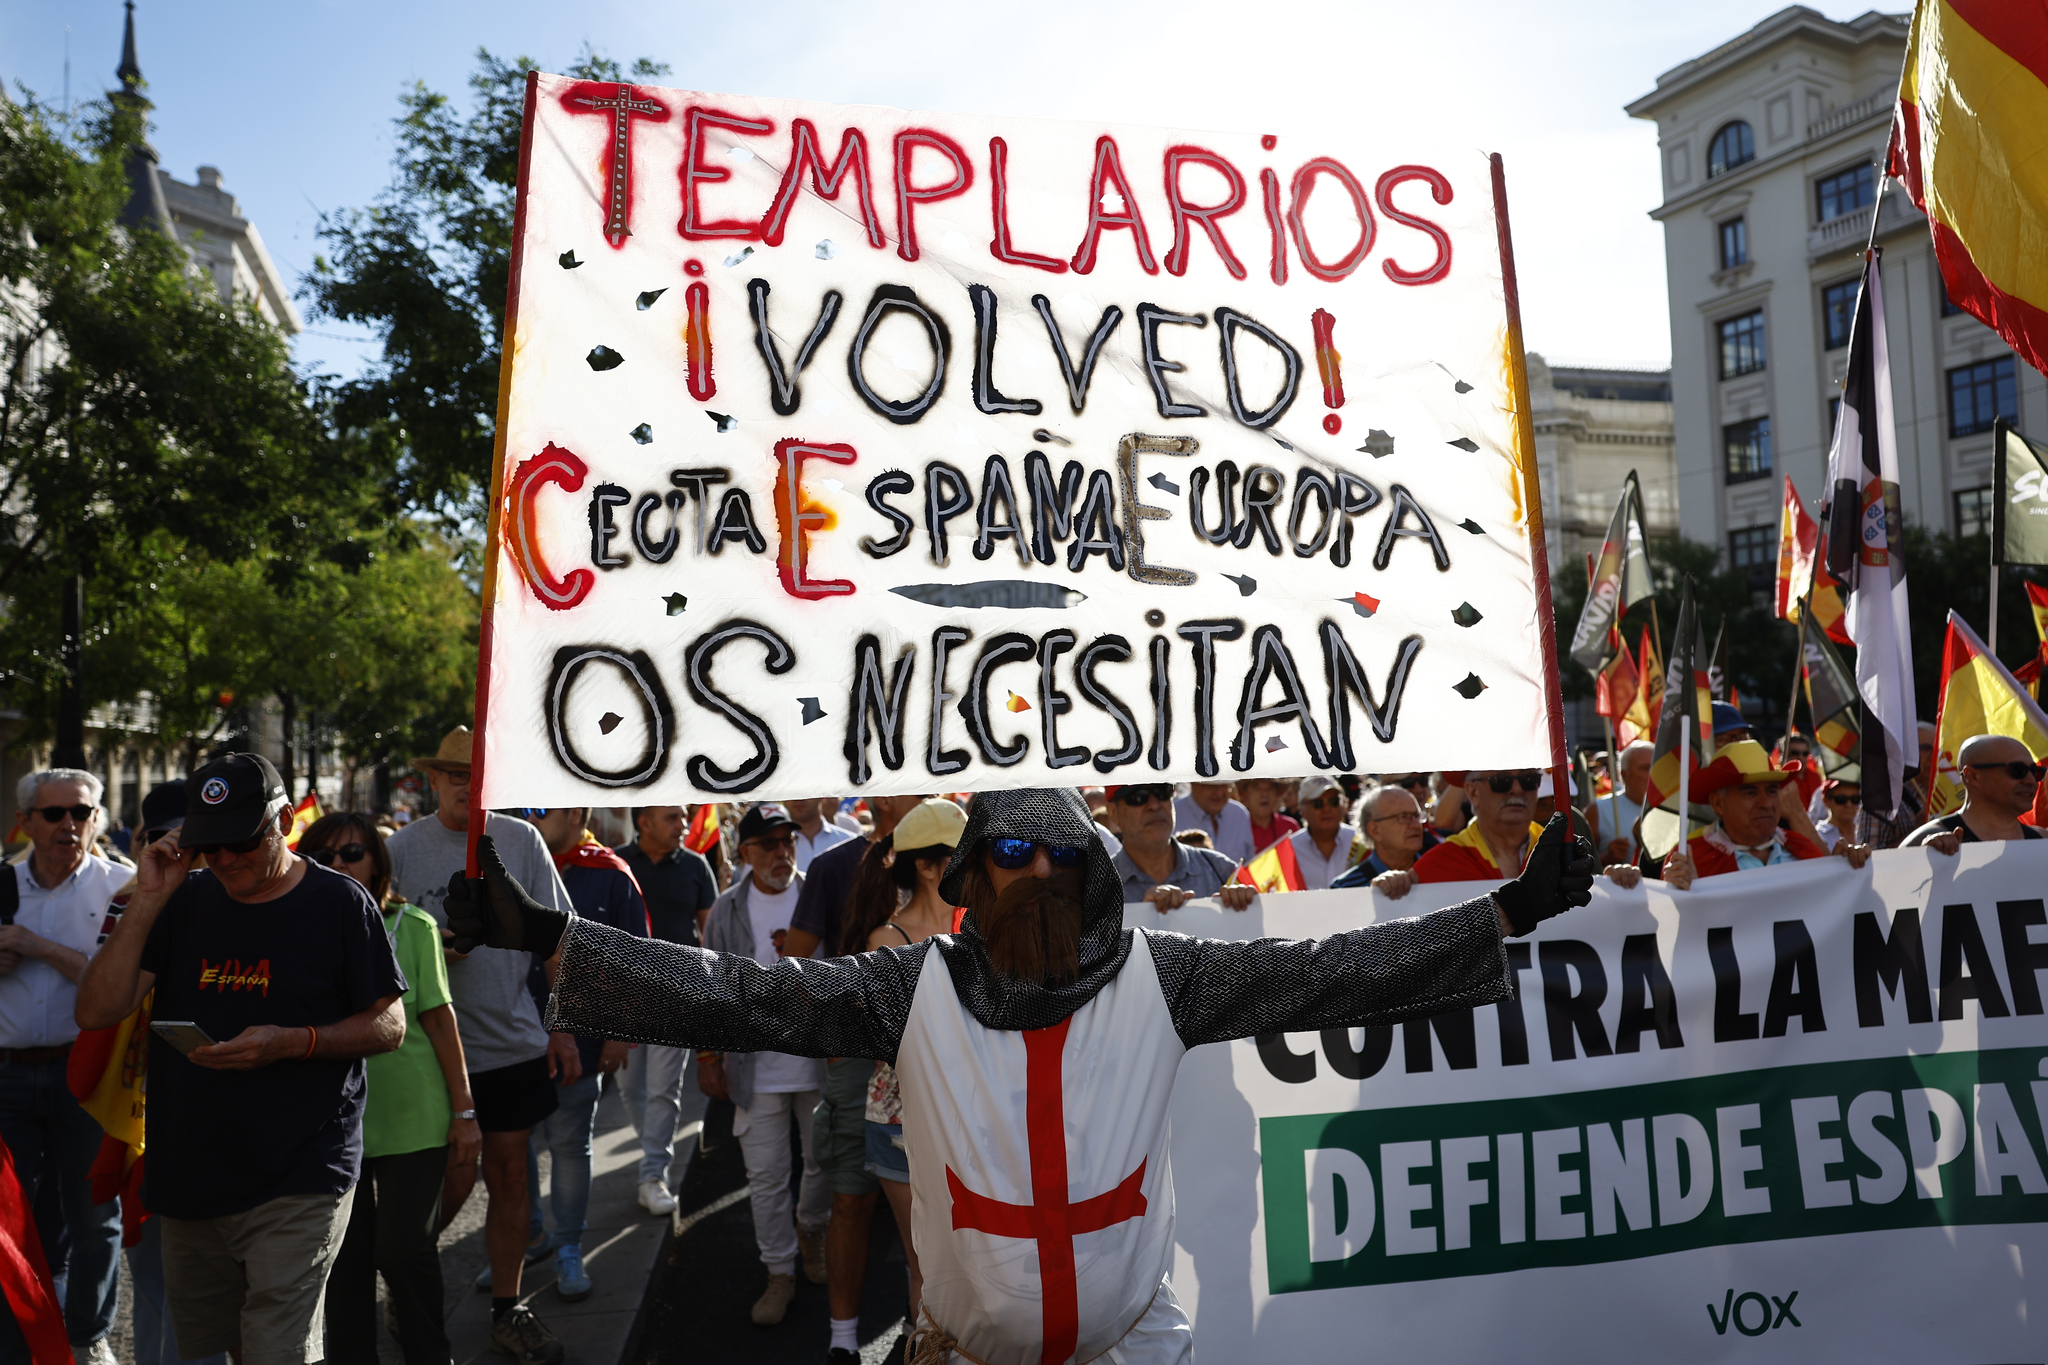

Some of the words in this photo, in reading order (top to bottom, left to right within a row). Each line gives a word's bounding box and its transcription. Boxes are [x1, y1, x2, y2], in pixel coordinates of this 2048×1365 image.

[560, 82, 1453, 286] TEMPLARIOS
[506, 441, 767, 611] CEUTA
[773, 428, 1126, 600] ESPAÑA
[1117, 432, 1451, 587] EUROPA
[546, 618, 796, 793] OS
[843, 609, 1424, 787] NECESITAN
[198, 957, 273, 998] VIVA
[1707, 919, 1828, 1044] LA
[1303, 1103, 1773, 1264] DEFIENDE
[1706, 1288, 1802, 1337] VOX
